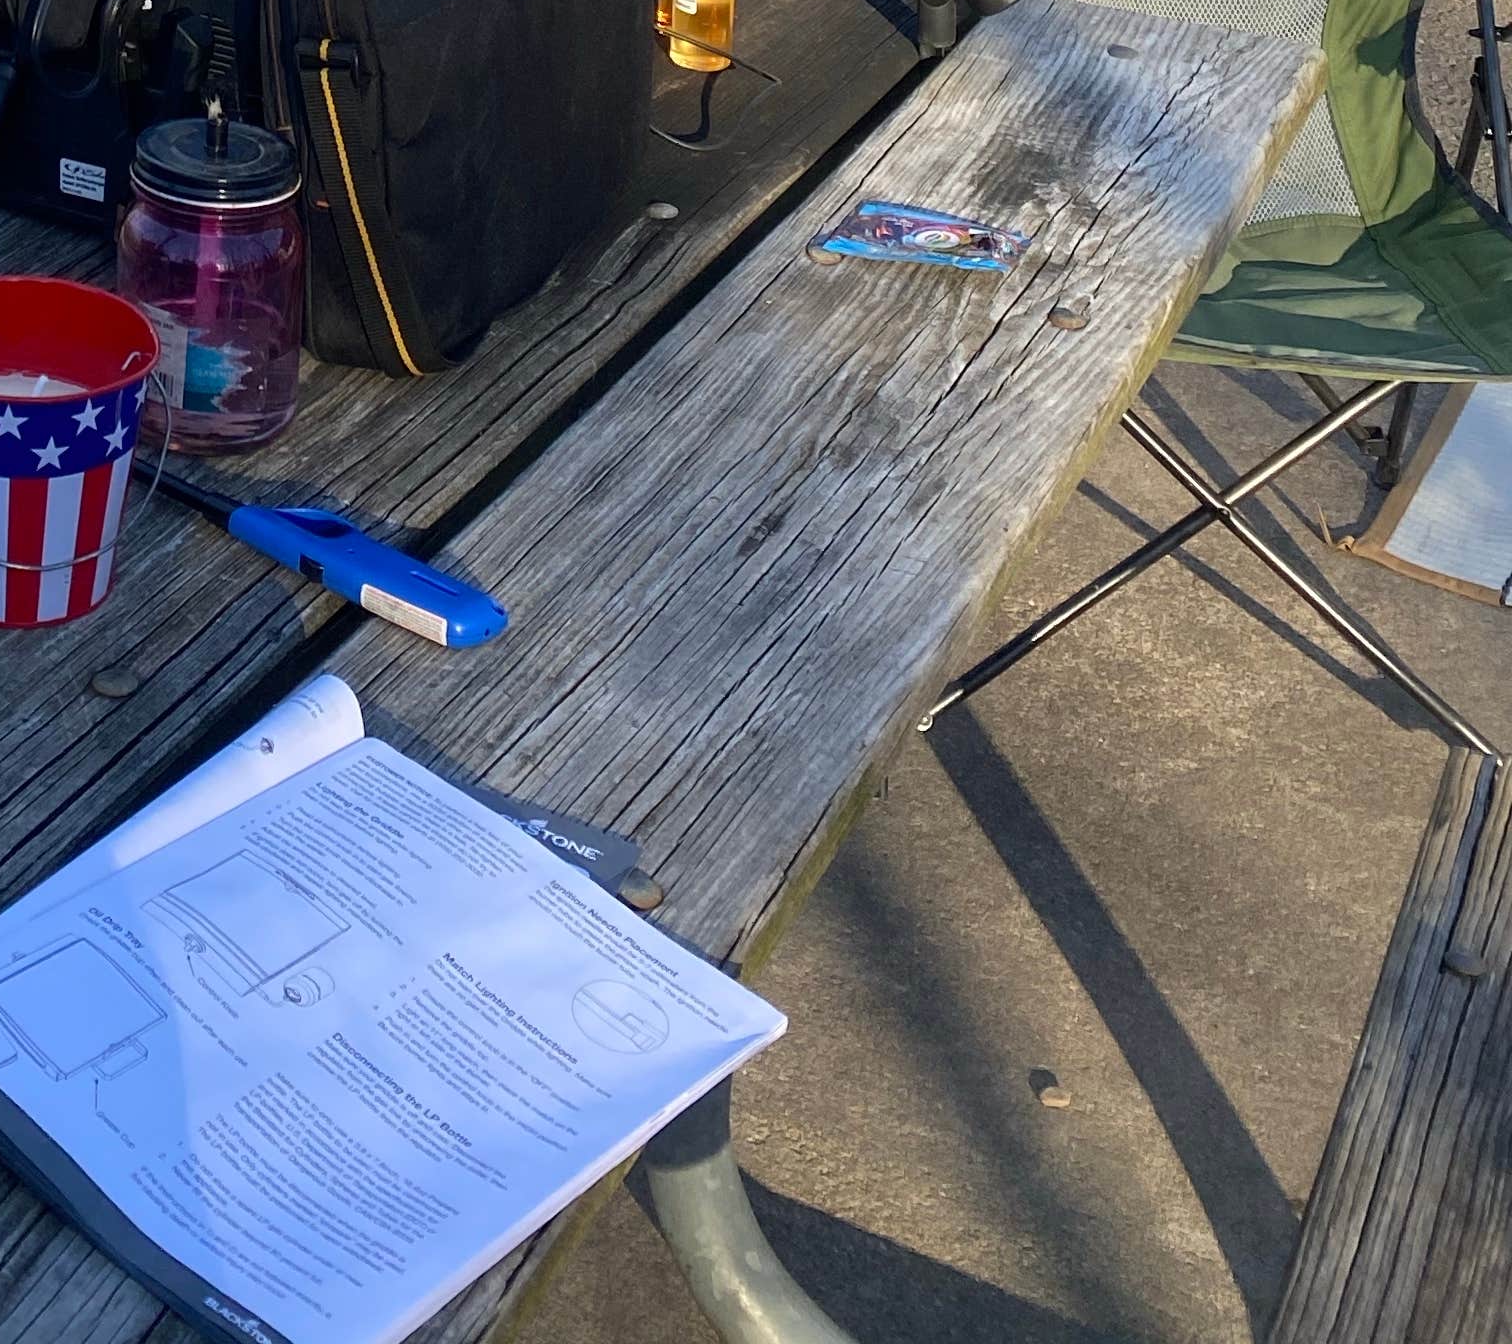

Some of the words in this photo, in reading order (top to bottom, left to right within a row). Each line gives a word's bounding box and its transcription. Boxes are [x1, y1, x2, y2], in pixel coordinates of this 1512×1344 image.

[314, 781, 354, 807] Lighting
[353, 805, 372, 816] the
[368, 814, 406, 839] Griddle
[87, 906, 105, 917] Oil
[100, 915, 125, 933] Drip
[121, 930, 145, 949] Tray
[548, 878, 588, 909] Ignition
[586, 908, 624, 937] Needle
[622, 935, 680, 977] Placement
[441, 952, 477, 981] Match
[473, 981, 517, 1017] Lighting
[515, 1015, 581, 1064] Instructions
[330, 1031, 405, 1094] Disconnecting
[402, 1092, 424, 1110] the
[422, 1108, 442, 1123] LP
[438, 1121, 474, 1148] Bottle
